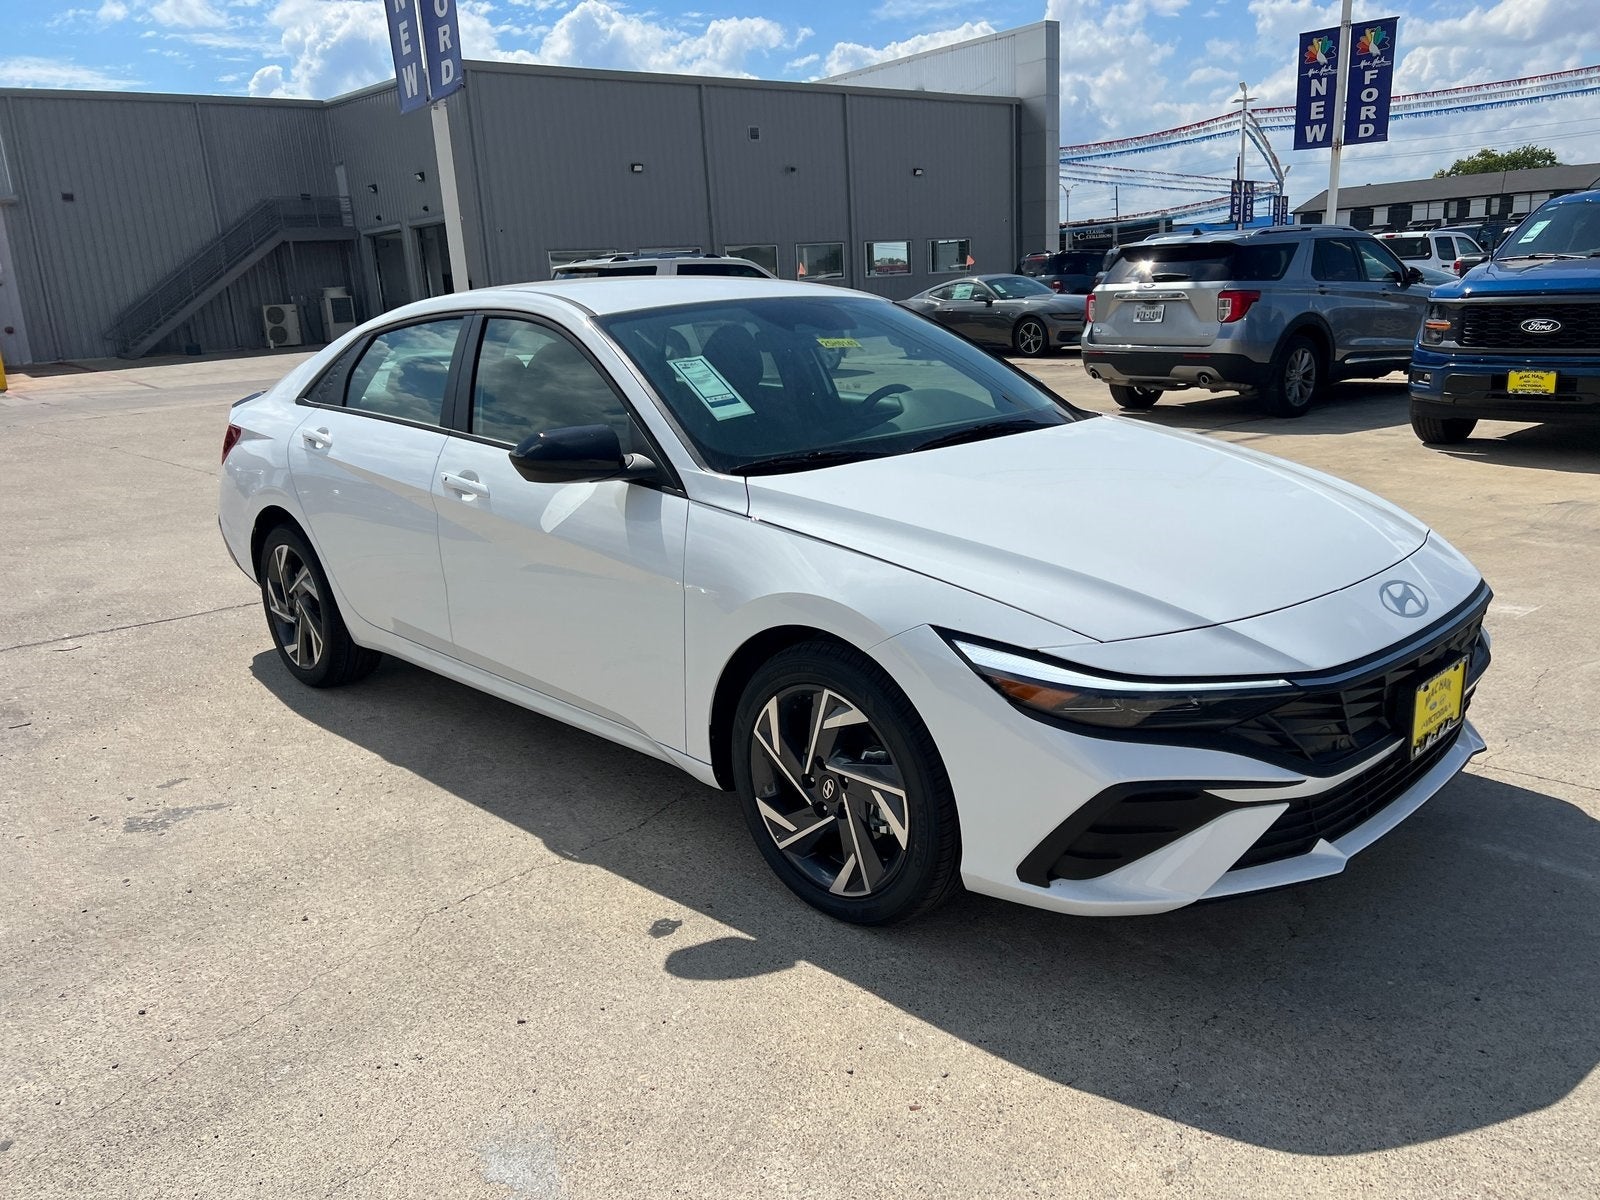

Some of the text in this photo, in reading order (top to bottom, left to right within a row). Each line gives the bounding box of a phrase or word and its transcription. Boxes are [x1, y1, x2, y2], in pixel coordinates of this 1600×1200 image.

[1305, 77, 1327, 143] NEW
[1358, 70, 1379, 138] FORD
[1528, 320, 1552, 331] Ford
